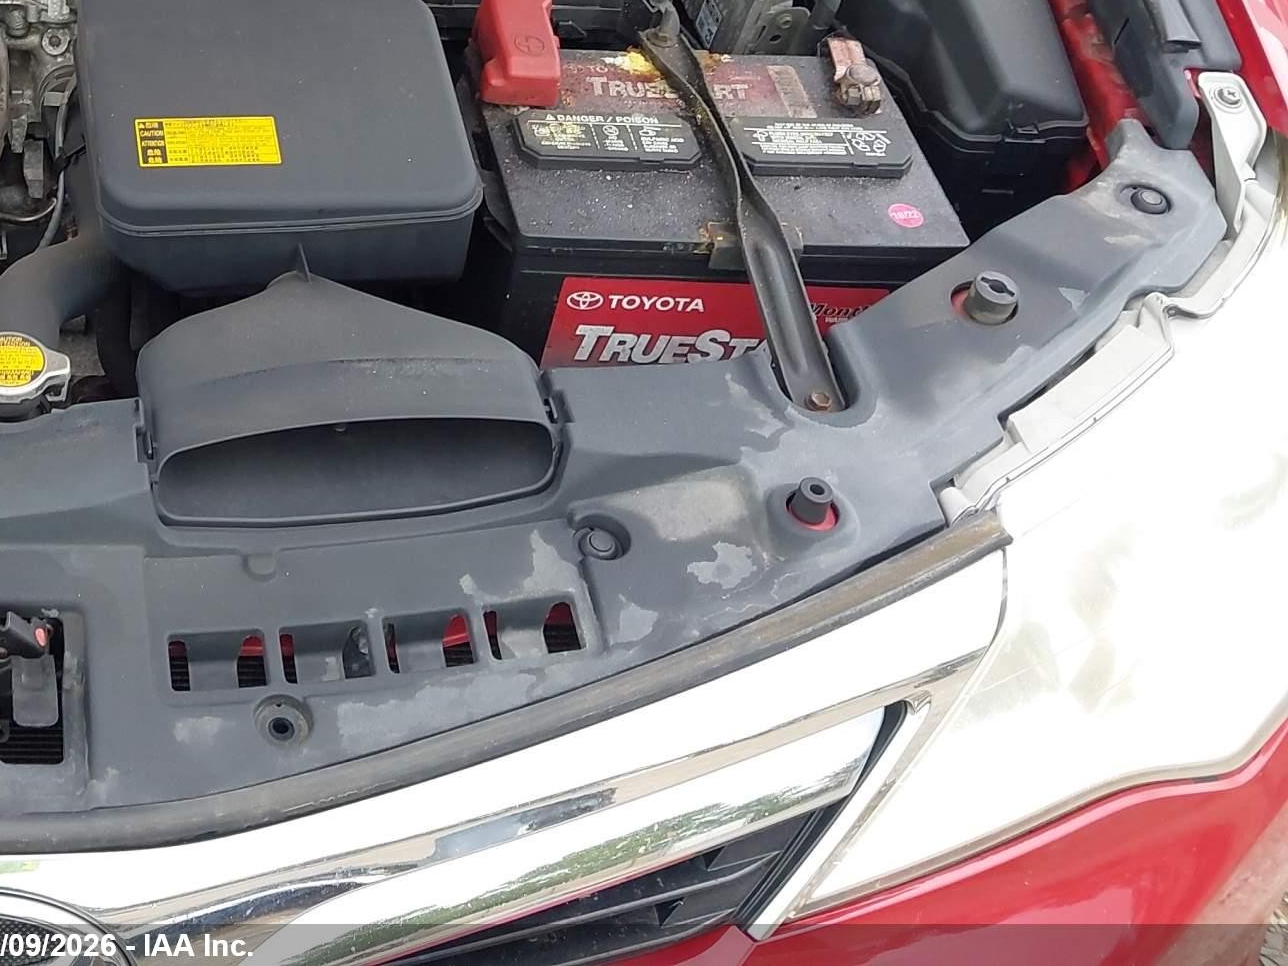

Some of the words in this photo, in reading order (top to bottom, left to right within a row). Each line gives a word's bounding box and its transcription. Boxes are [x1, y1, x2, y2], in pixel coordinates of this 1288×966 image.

[557, 114, 604, 122] DANGER
[616, 116, 659, 124] POISON
[608, 295, 705, 312] TOYOTA
